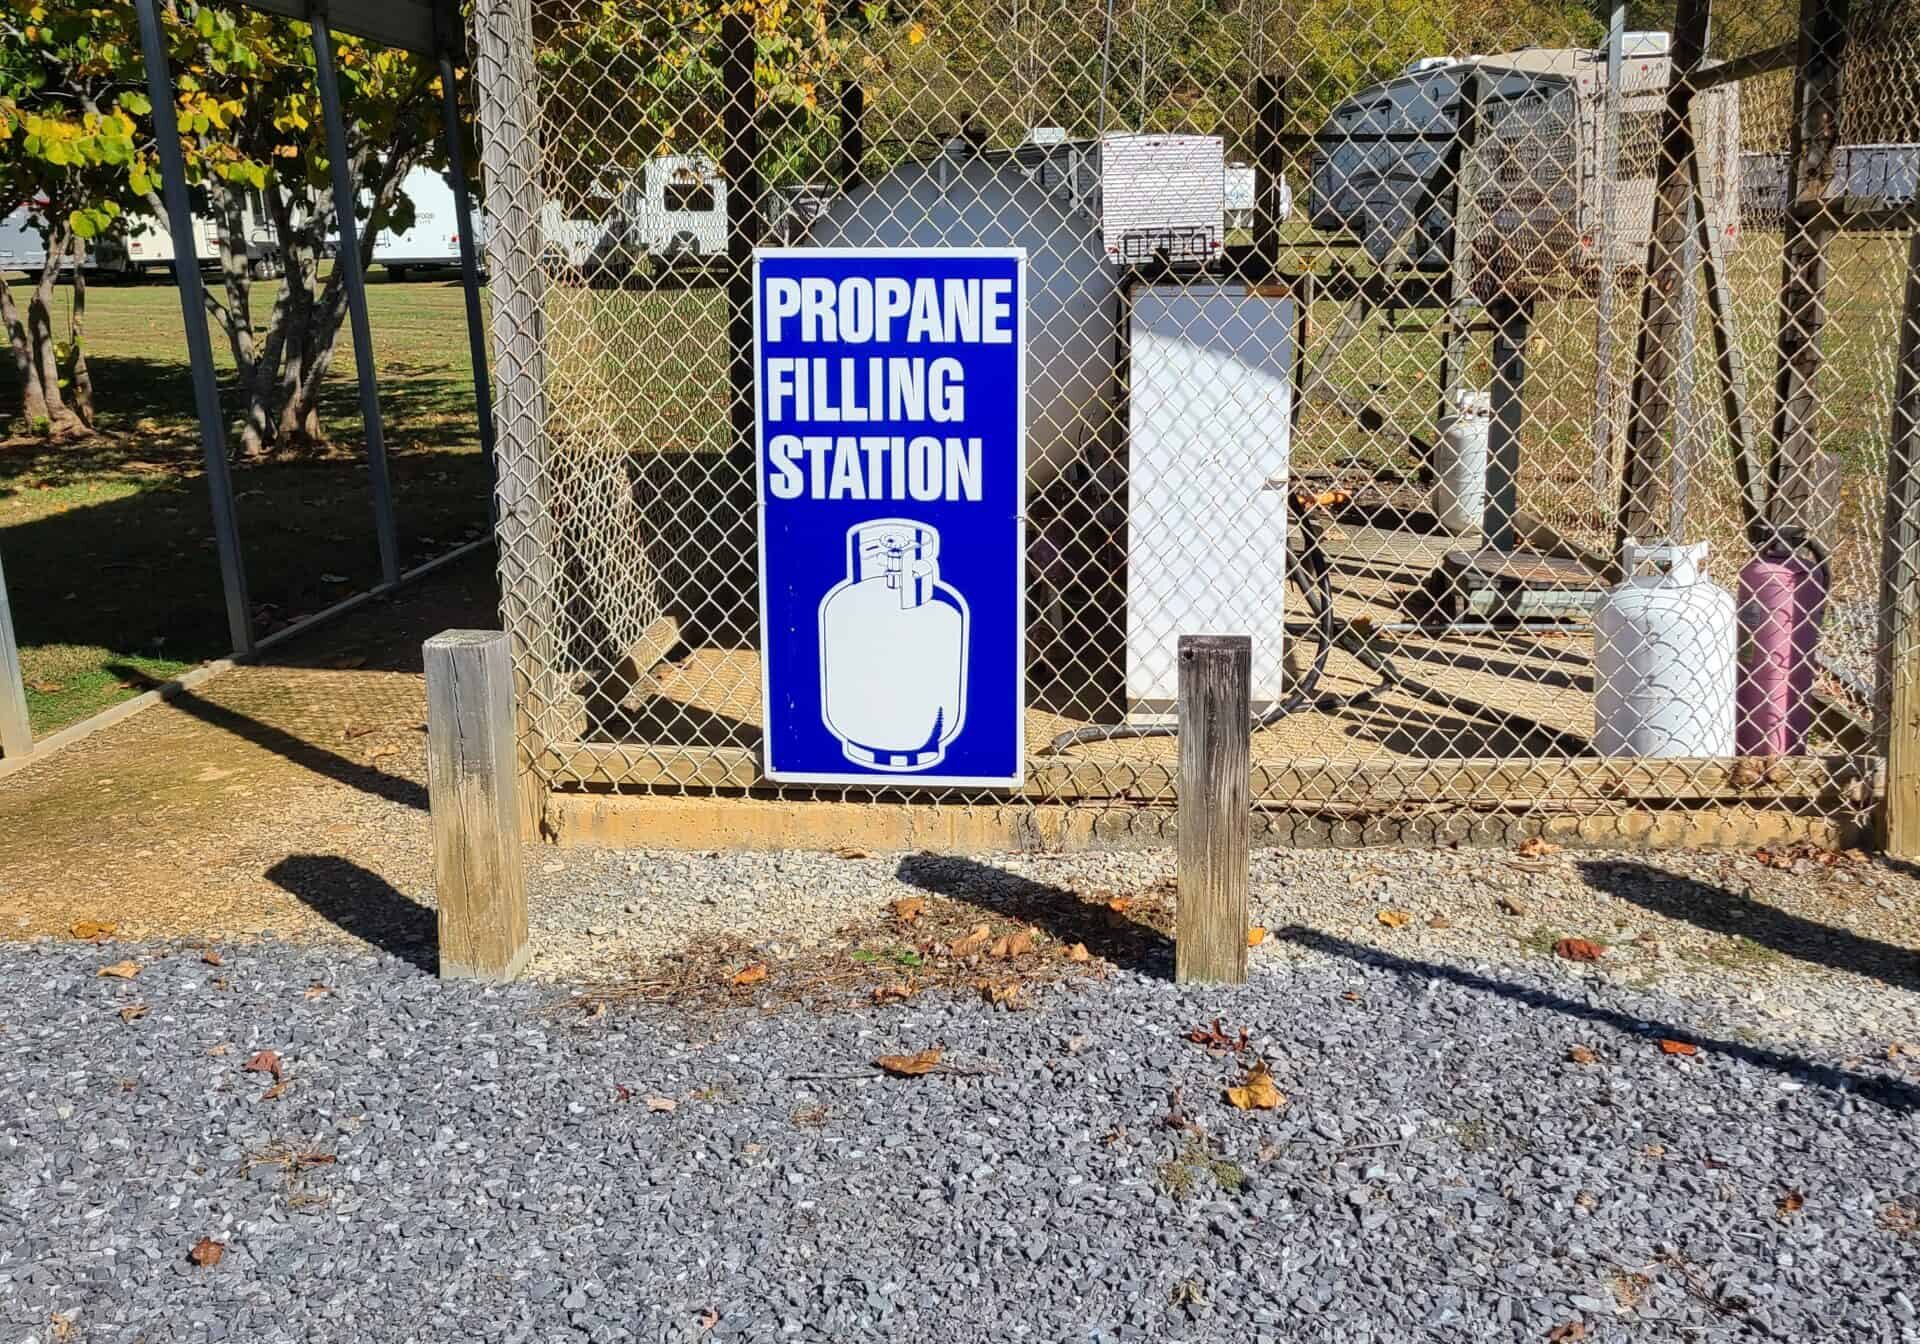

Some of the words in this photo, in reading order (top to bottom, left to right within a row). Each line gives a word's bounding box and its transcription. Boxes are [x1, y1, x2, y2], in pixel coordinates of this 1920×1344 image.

[767, 278, 1012, 343] PROPANE
[768, 357, 965, 422] FILLING
[769, 435, 982, 501] STATION
